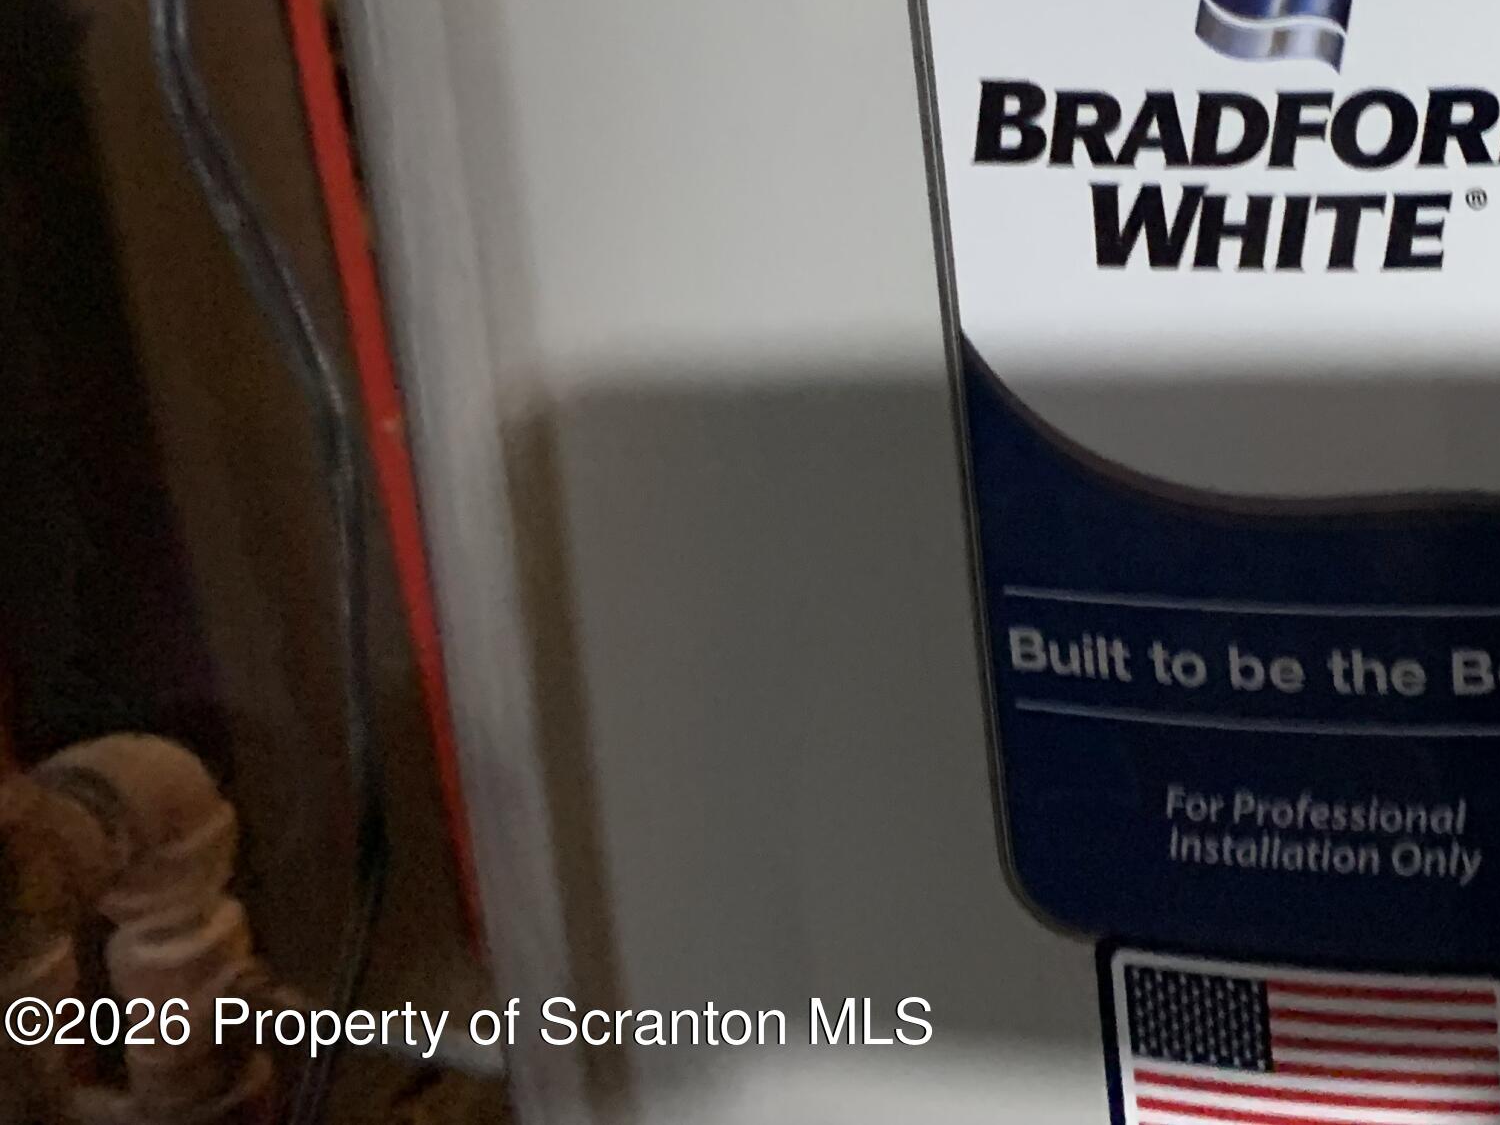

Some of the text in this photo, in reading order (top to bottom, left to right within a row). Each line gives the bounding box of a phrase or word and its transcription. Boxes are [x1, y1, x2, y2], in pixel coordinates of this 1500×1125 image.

[1008, 625, 1131, 681] Built
[1147, 640, 1208, 688] to
[1227, 644, 1306, 693] be
[1326, 648, 1427, 698] the
[1166, 783, 1466, 836] For Professional
[1171, 825, 1482, 888] Installation Only
